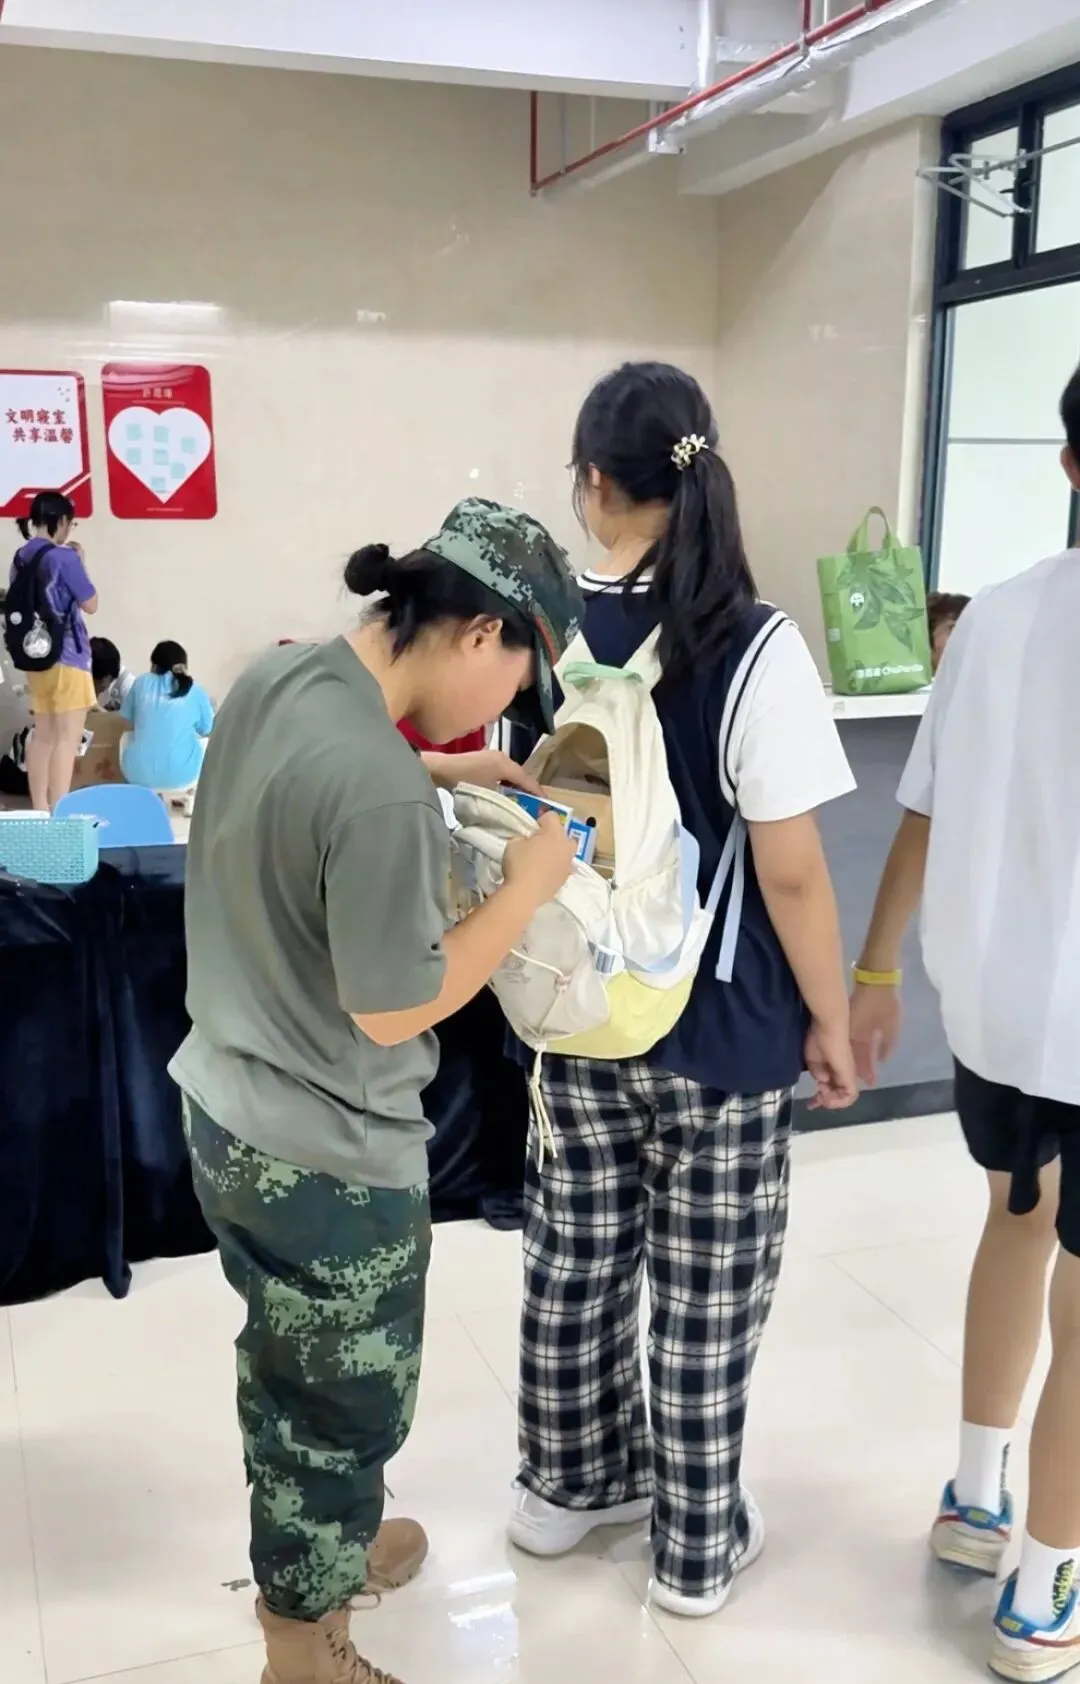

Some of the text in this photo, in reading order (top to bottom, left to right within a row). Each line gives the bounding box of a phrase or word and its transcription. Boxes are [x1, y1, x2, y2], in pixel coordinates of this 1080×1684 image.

[5, 408, 66, 424] 文明寝室
[13, 427, 73, 444] 共享温馨
